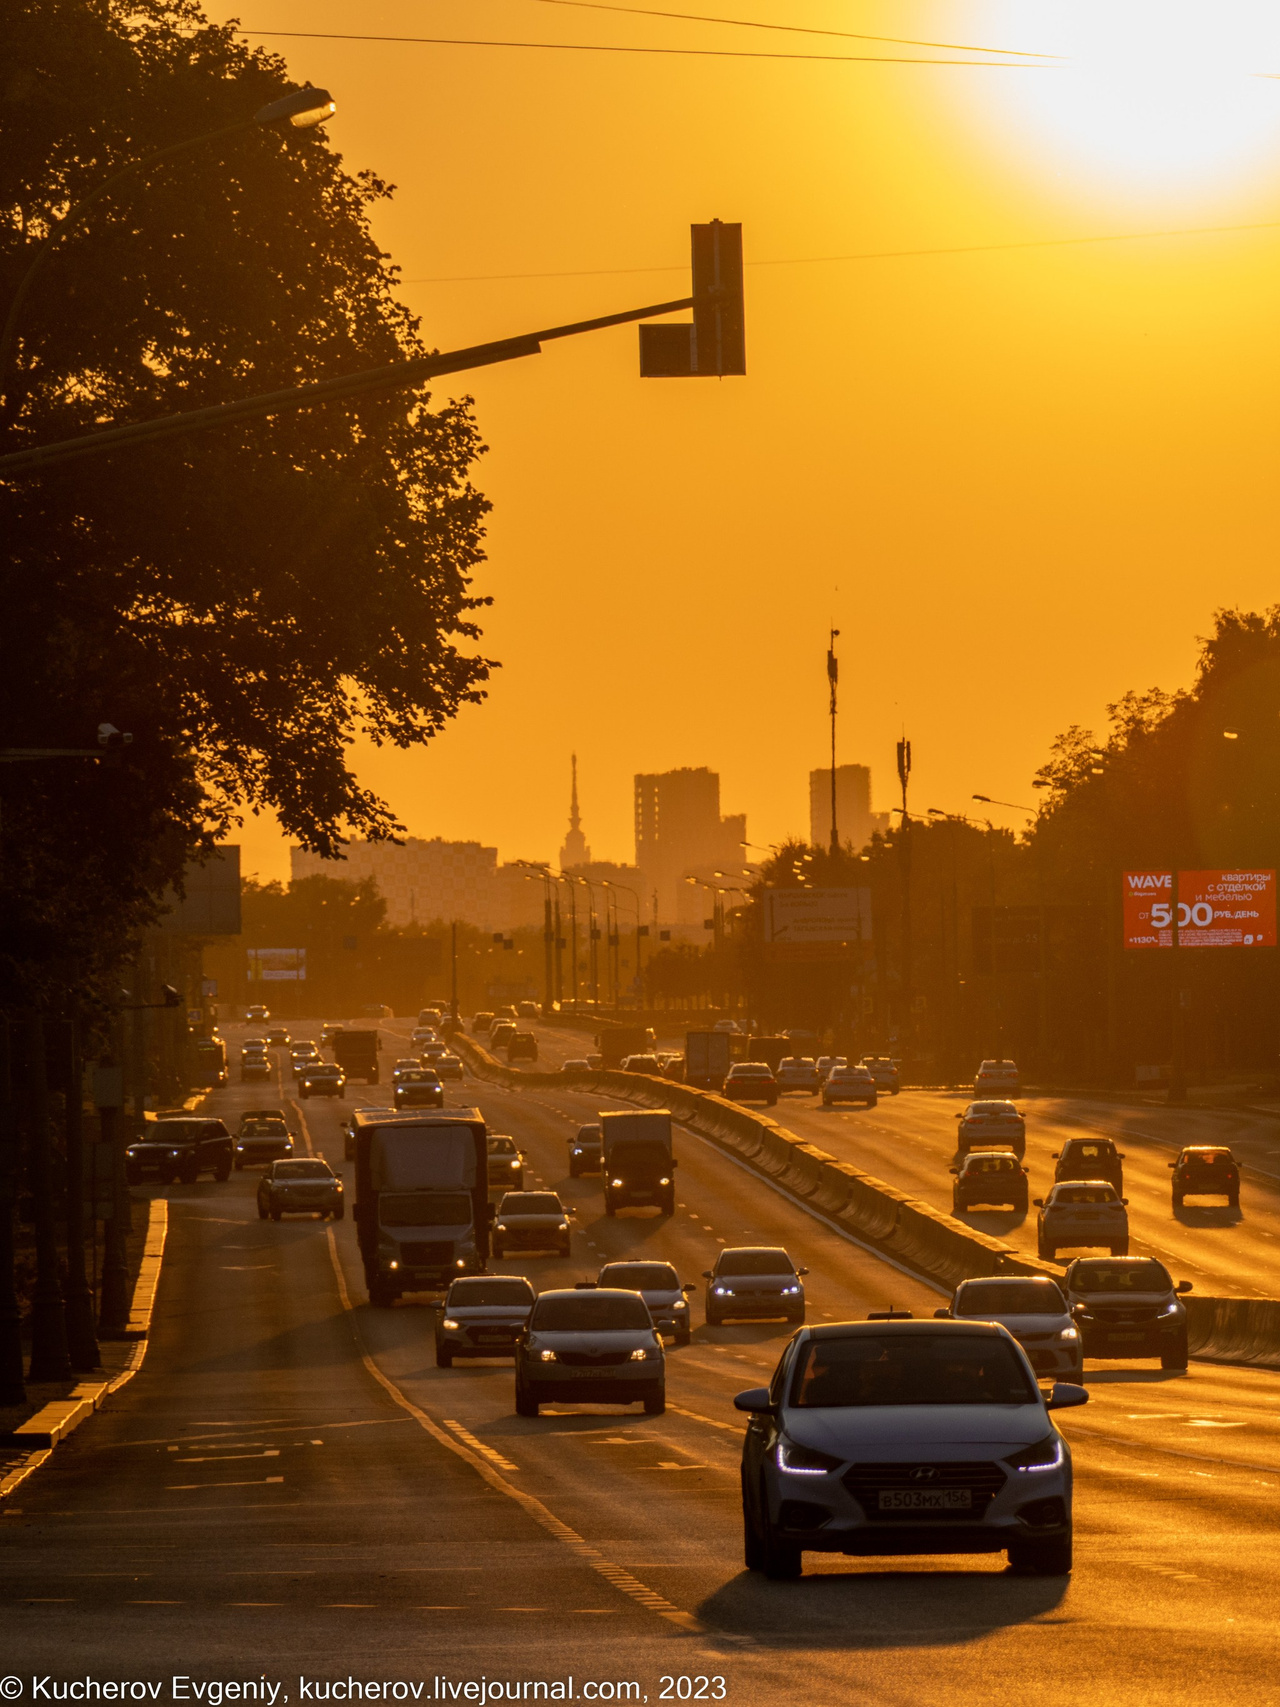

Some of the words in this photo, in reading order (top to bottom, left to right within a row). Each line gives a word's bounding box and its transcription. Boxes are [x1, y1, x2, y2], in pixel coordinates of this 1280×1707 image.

[1127, 875, 1172, 889] WAVE
[1221, 873, 1271, 883] квартиры
[1207, 884, 1214, 892] с
[1216, 881, 1266, 892] отделкой
[1205, 892, 1253, 902] мебелью
[1151, 902, 1213, 928] 500
[883, 1492, 942, 1507] В503МХ
[945, 1491, 970, 1503] 156
